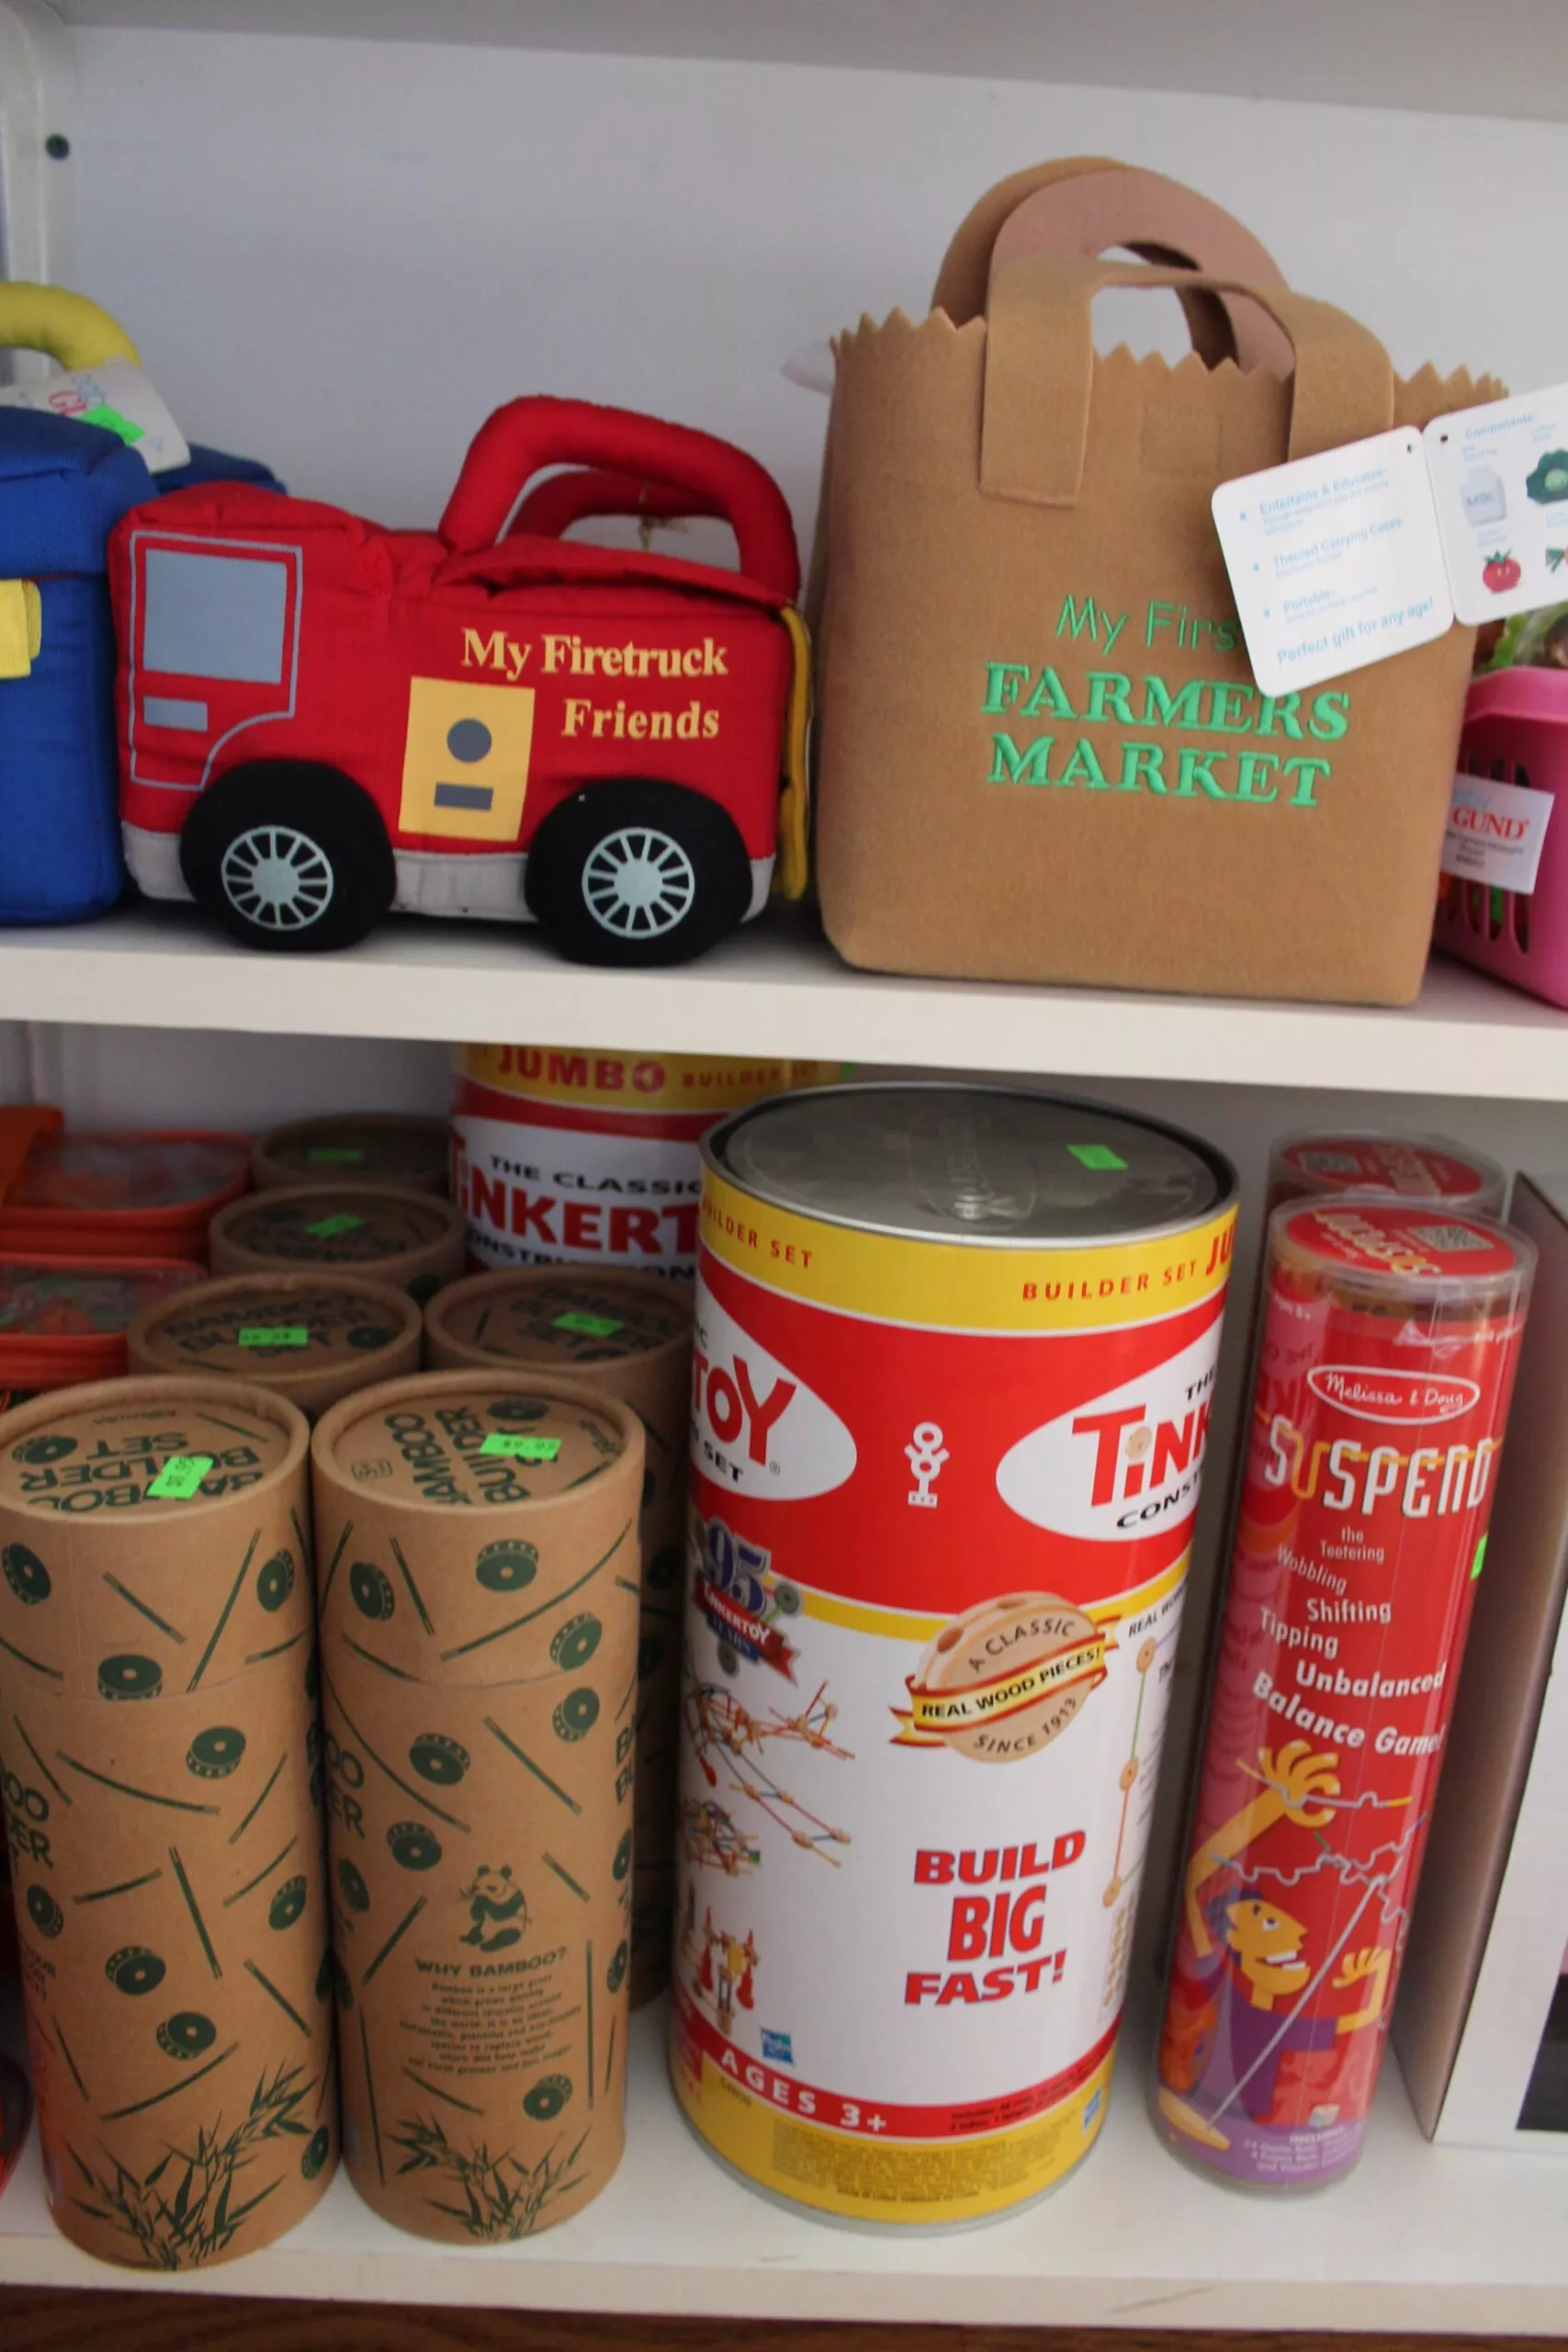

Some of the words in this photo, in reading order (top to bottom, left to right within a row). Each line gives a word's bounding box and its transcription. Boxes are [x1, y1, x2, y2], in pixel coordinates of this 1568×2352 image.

[1273, 543, 1319, 567] Themed
[1321, 528, 1369, 551] Carrying
[1056, 593, 1130, 657] My
[1145, 598, 1239, 651] Firs
[1277, 636, 1330, 666] Perfect
[1332, 627, 1357, 651] gift
[1358, 619, 1379, 639] for
[1381, 609, 1405, 630] any
[1407, 595, 1436, 620] age!
[462, 628, 532, 682] My
[541, 634, 728, 678] Firetruck
[561, 698, 719, 739] Friends
[980, 661, 1350, 741] FARMERS
[986, 732, 1331, 807] MARKET
[1452, 805, 1527, 840] GUND
[497, 1044, 666, 1094] JUMBO
[682, 1066, 781, 1089] BUILDER
[491, 1154, 541, 1182] THE
[553, 1170, 701, 1194] CLASSIC
[770, 1238, 813, 1271] SET
[1021, 1272, 1150, 1301] BUILDER
[1162, 1260, 1197, 1286] SET
[1325, 1372, 1404, 1406] Melissa
[1423, 1387, 1465, 1409] Doug
[18, 1445, 261, 1494] BULDER
[85, 1431, 189, 1461] SET
[703, 1440, 744, 1483] SET
[1264, 1414, 1495, 1519] SUSPEND
[1320, 1539, 1385, 1566] Teetering
[1340, 1525, 1364, 1544] the
[1278, 1544, 1348, 1597] Wobbling
[1128, 1611, 1157, 1638] REAL
[1260, 1605, 1339, 1660] Tipping
[1306, 1598, 1393, 1625] Shifting
[968, 1656, 987, 1675] A
[986, 1615, 1077, 1656] CLASSIC
[921, 1702, 974, 1720] REAL
[976, 1678, 1036, 1712] WOOD
[1039, 1645, 1102, 1684] PIECES!
[1295, 1659, 1448, 1700] Unbalanced
[974, 1732, 1037, 1755] SINCE
[1042, 1696, 1078, 1736] 1913
[1252, 1668, 1366, 1748] Balance
[913, 1828, 1087, 1886] BUILD
[947, 1883, 1048, 1963] BIG
[415, 1957, 462, 1978] WHY
[469, 1945, 569, 1978] BAMBOO?
[904, 1947, 1067, 2007] FAST!
[720, 2048, 818, 2116] AGES
[840, 2101, 887, 2132] 3+
